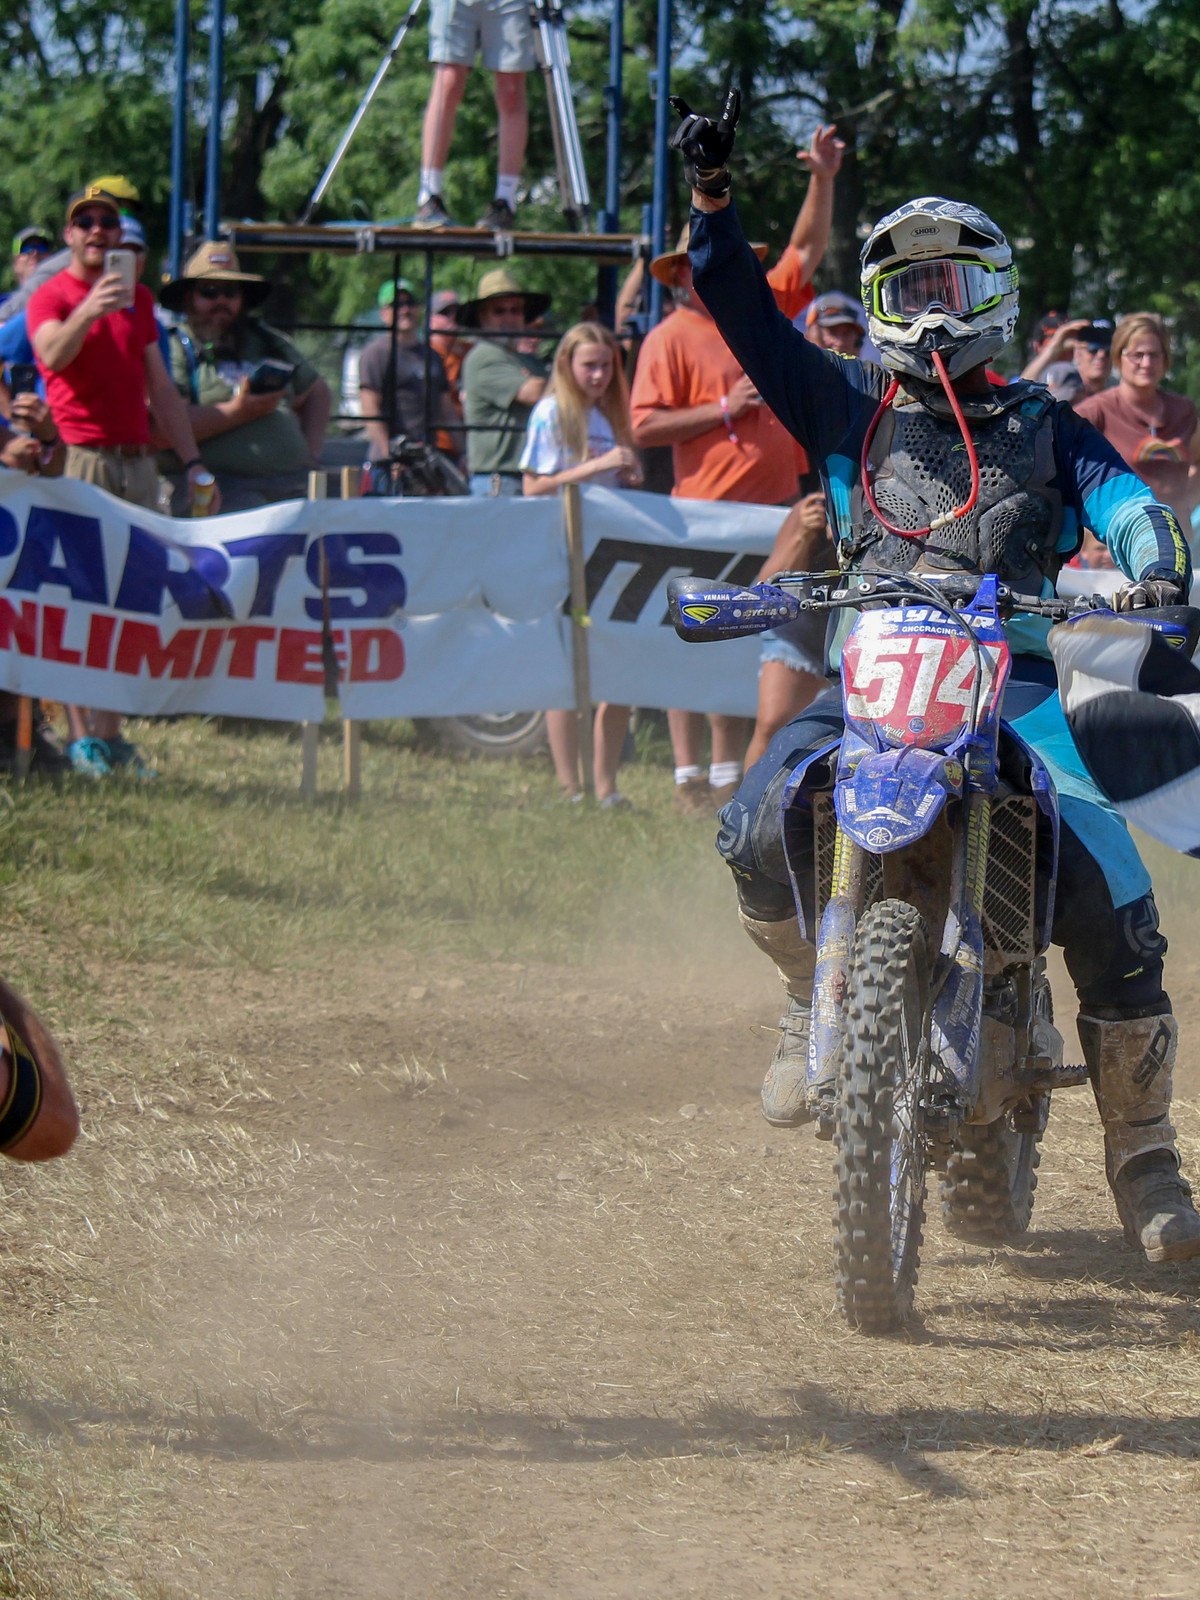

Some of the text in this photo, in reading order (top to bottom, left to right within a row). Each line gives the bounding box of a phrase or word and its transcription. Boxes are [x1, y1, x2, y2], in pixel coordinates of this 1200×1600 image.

[0, 596, 406, 684] NLIMITED
[862, 609, 996, 629] AYLOR
[902, 625, 969, 637] GNCCRACING.co
[847, 637, 1002, 724] 514
